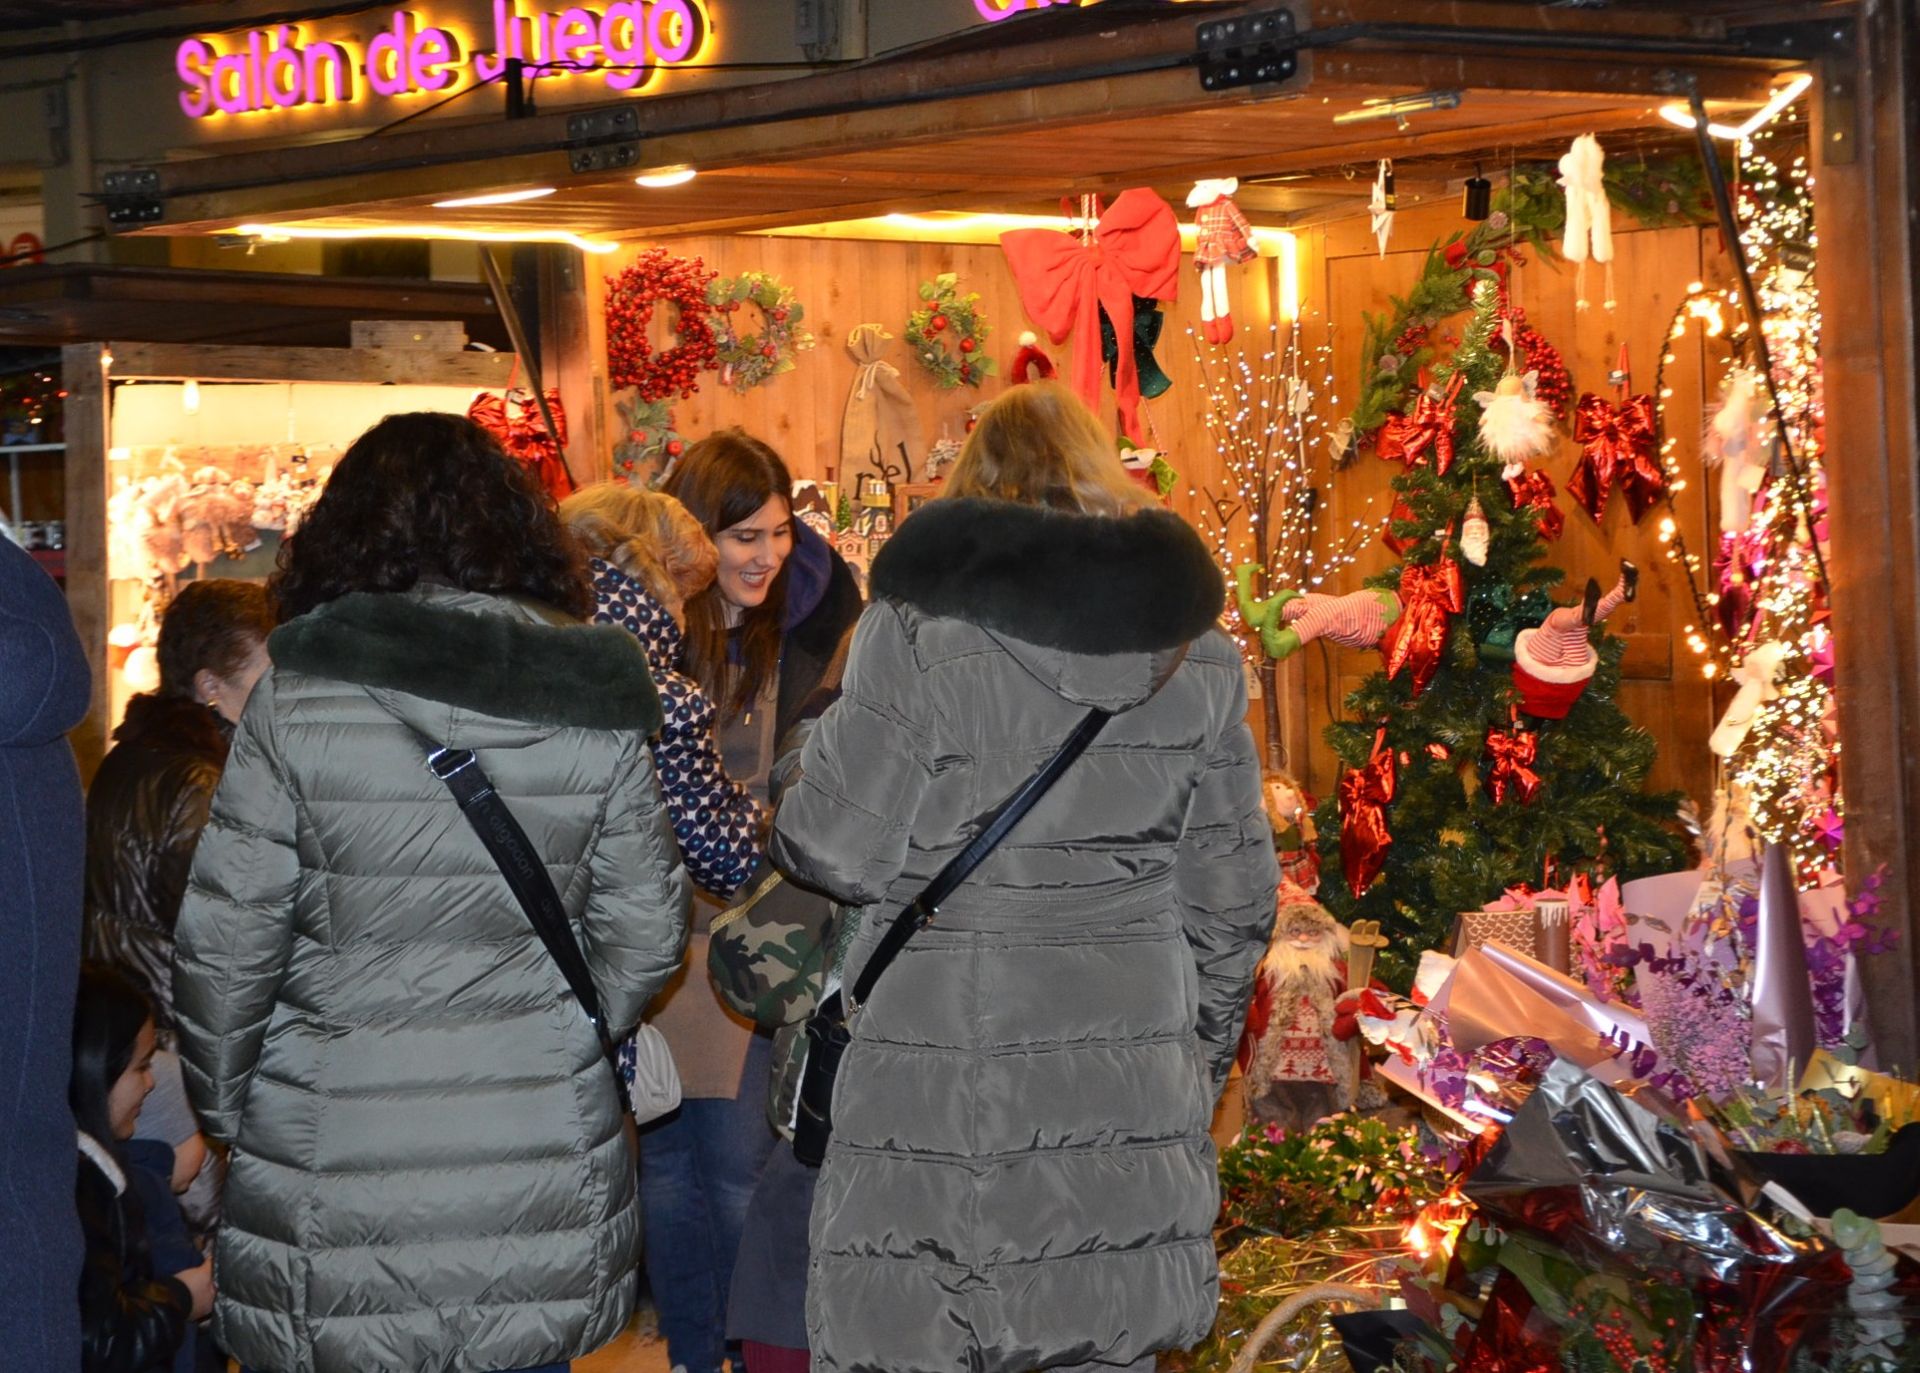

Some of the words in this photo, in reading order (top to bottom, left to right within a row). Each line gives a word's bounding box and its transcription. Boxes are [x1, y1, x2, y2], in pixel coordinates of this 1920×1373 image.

[176, 24, 344, 118] Salón
[366, 10, 451, 96] de
[474, 0, 694, 90] Juego
